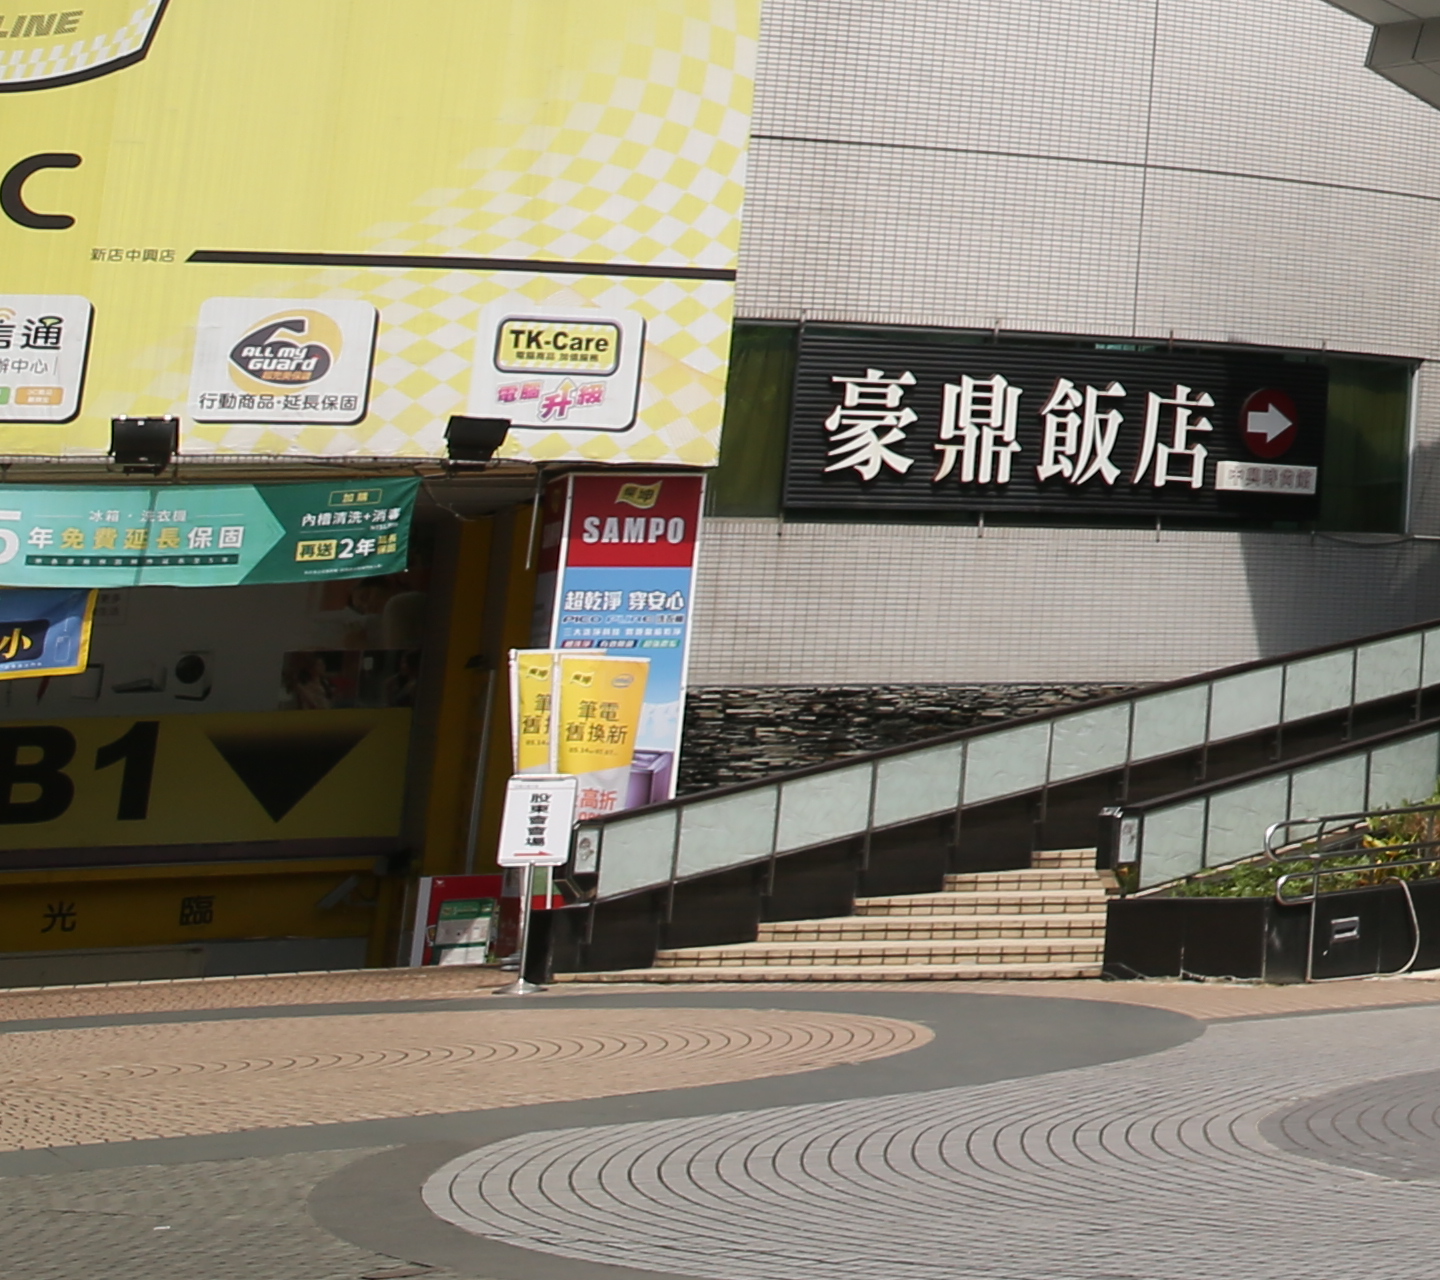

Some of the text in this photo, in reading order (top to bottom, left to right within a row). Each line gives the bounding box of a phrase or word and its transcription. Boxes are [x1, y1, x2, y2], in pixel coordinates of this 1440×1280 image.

[89, 247, 177, 264] 新店中興店
[241, 346, 275, 358] ALL
[509, 329, 609, 353] TK-Care
[498, 379, 604, 418] 電腦升級
[823, 368, 1218, 490] 豪鼎飯店
[582, 515, 686, 544] SAMPO
[563, 590, 685, 611] 超乾淨 穿安心
[577, 699, 620, 723] 筆電
[565, 721, 629, 745] 舊換新
[0, 720, 160, 826] B1
[576, 787, 618, 811] 高折
[525, 792, 552, 847] 股東會會場
